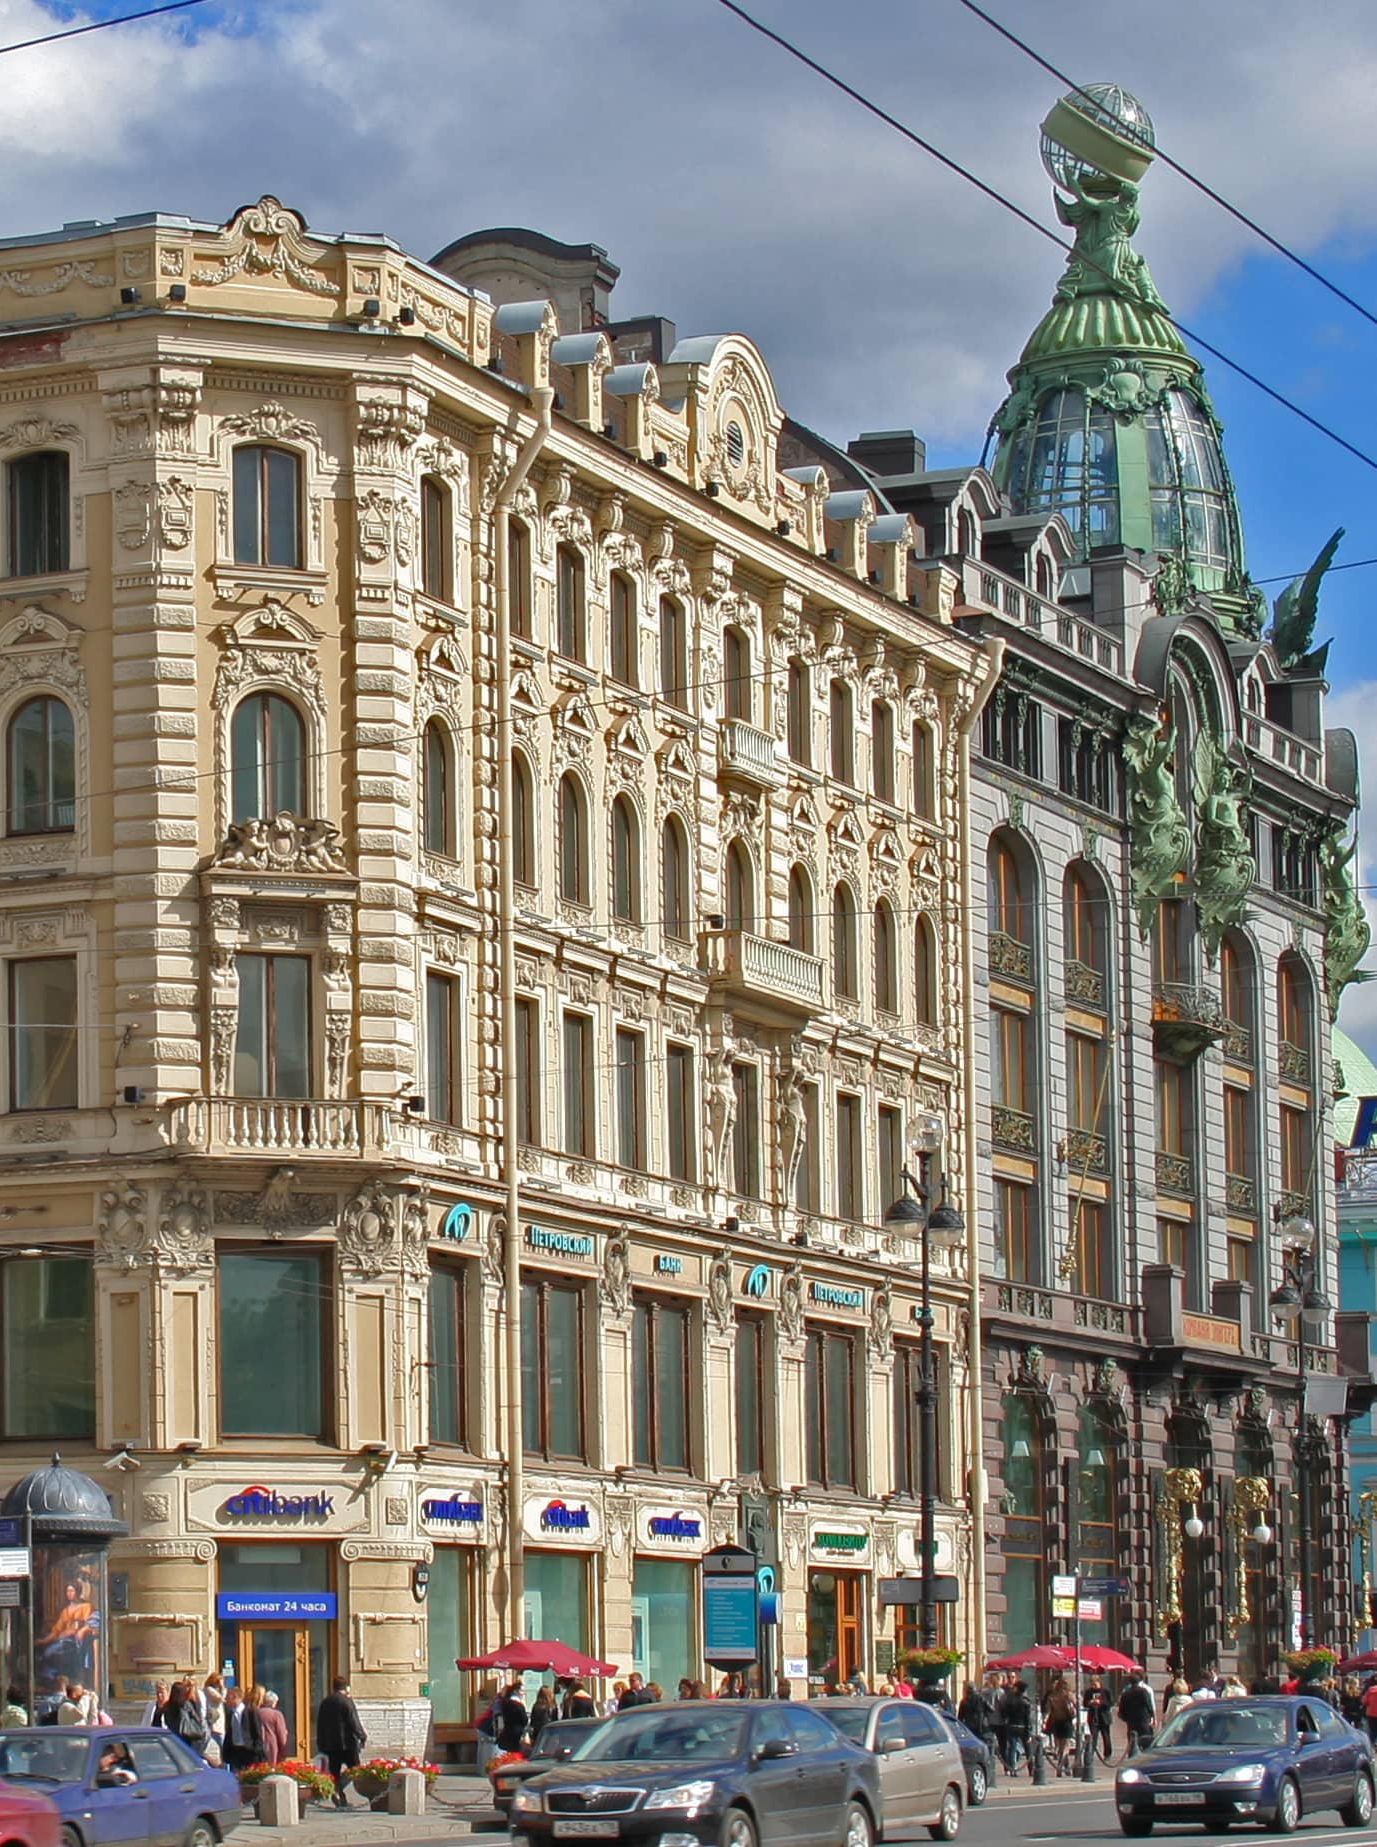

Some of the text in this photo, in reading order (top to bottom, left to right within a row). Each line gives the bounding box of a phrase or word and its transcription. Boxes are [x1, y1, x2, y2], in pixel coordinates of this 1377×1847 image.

[226, 1486, 335, 1516] citibank
[227, 1602, 327, 1613] Банкомат 24 часа
